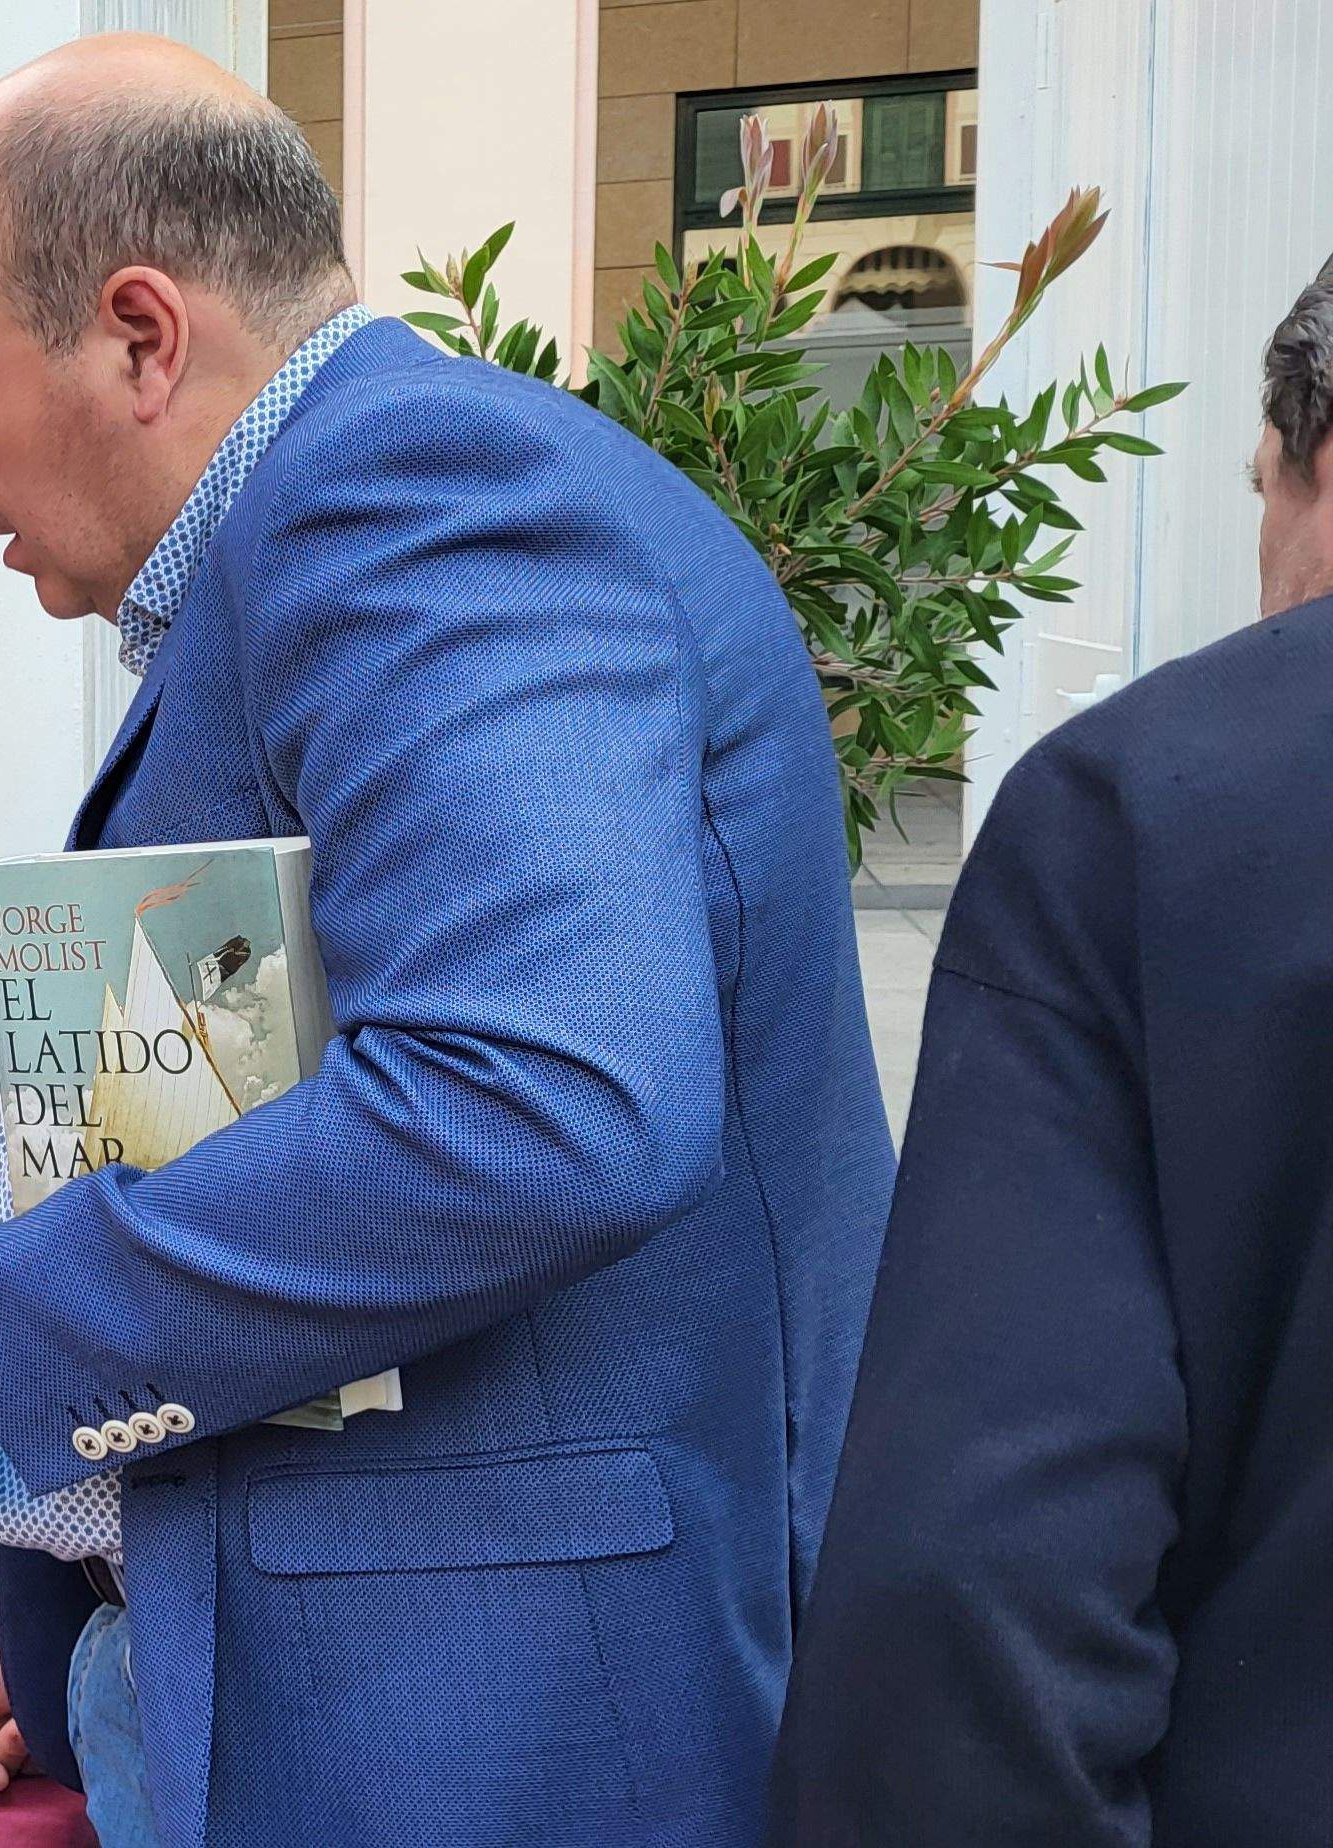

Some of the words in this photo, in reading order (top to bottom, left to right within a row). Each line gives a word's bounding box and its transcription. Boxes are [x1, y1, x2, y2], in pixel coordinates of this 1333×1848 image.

[0, 978, 52, 1022] EL
[6, 1028, 193, 1075] LATIDO
[13, 1082, 103, 1128] DEL
